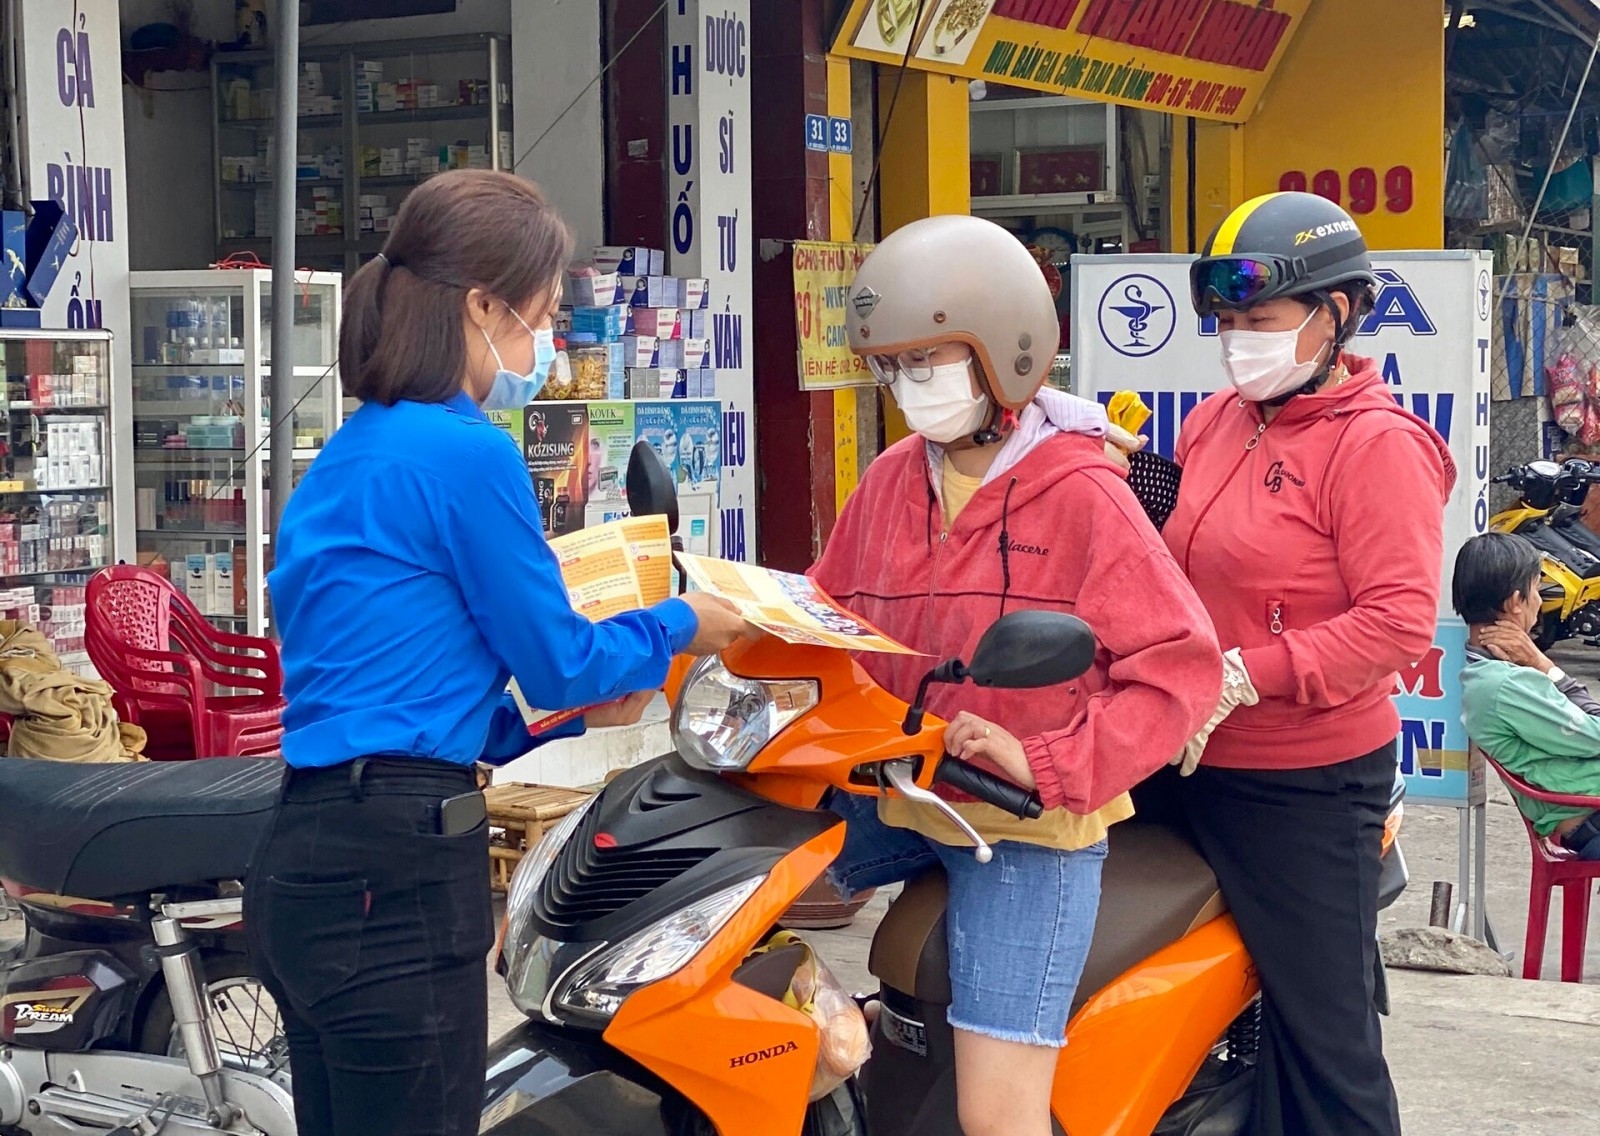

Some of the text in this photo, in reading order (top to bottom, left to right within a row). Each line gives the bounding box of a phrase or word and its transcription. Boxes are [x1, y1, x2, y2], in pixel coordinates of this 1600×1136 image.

[57, 13, 95, 109] CẢ
[705, 11, 746, 86] DƯỢC
[983, 40, 1018, 75] MUA
[1010, 41, 1044, 80] BÁN
[1034, 50, 1062, 83] GIA
[1080, 59, 1115, 93] TRAO
[719, 110, 734, 174] SĨ
[811, 119, 823, 140] 31
[834, 122, 847, 142] 33
[718, 208, 738, 272] TƯ
[713, 295, 742, 369] VẤN
[720, 401, 745, 477] IỆU
[996, 536, 1049, 556] lacere
[730, 1040, 798, 1068] HONDA
